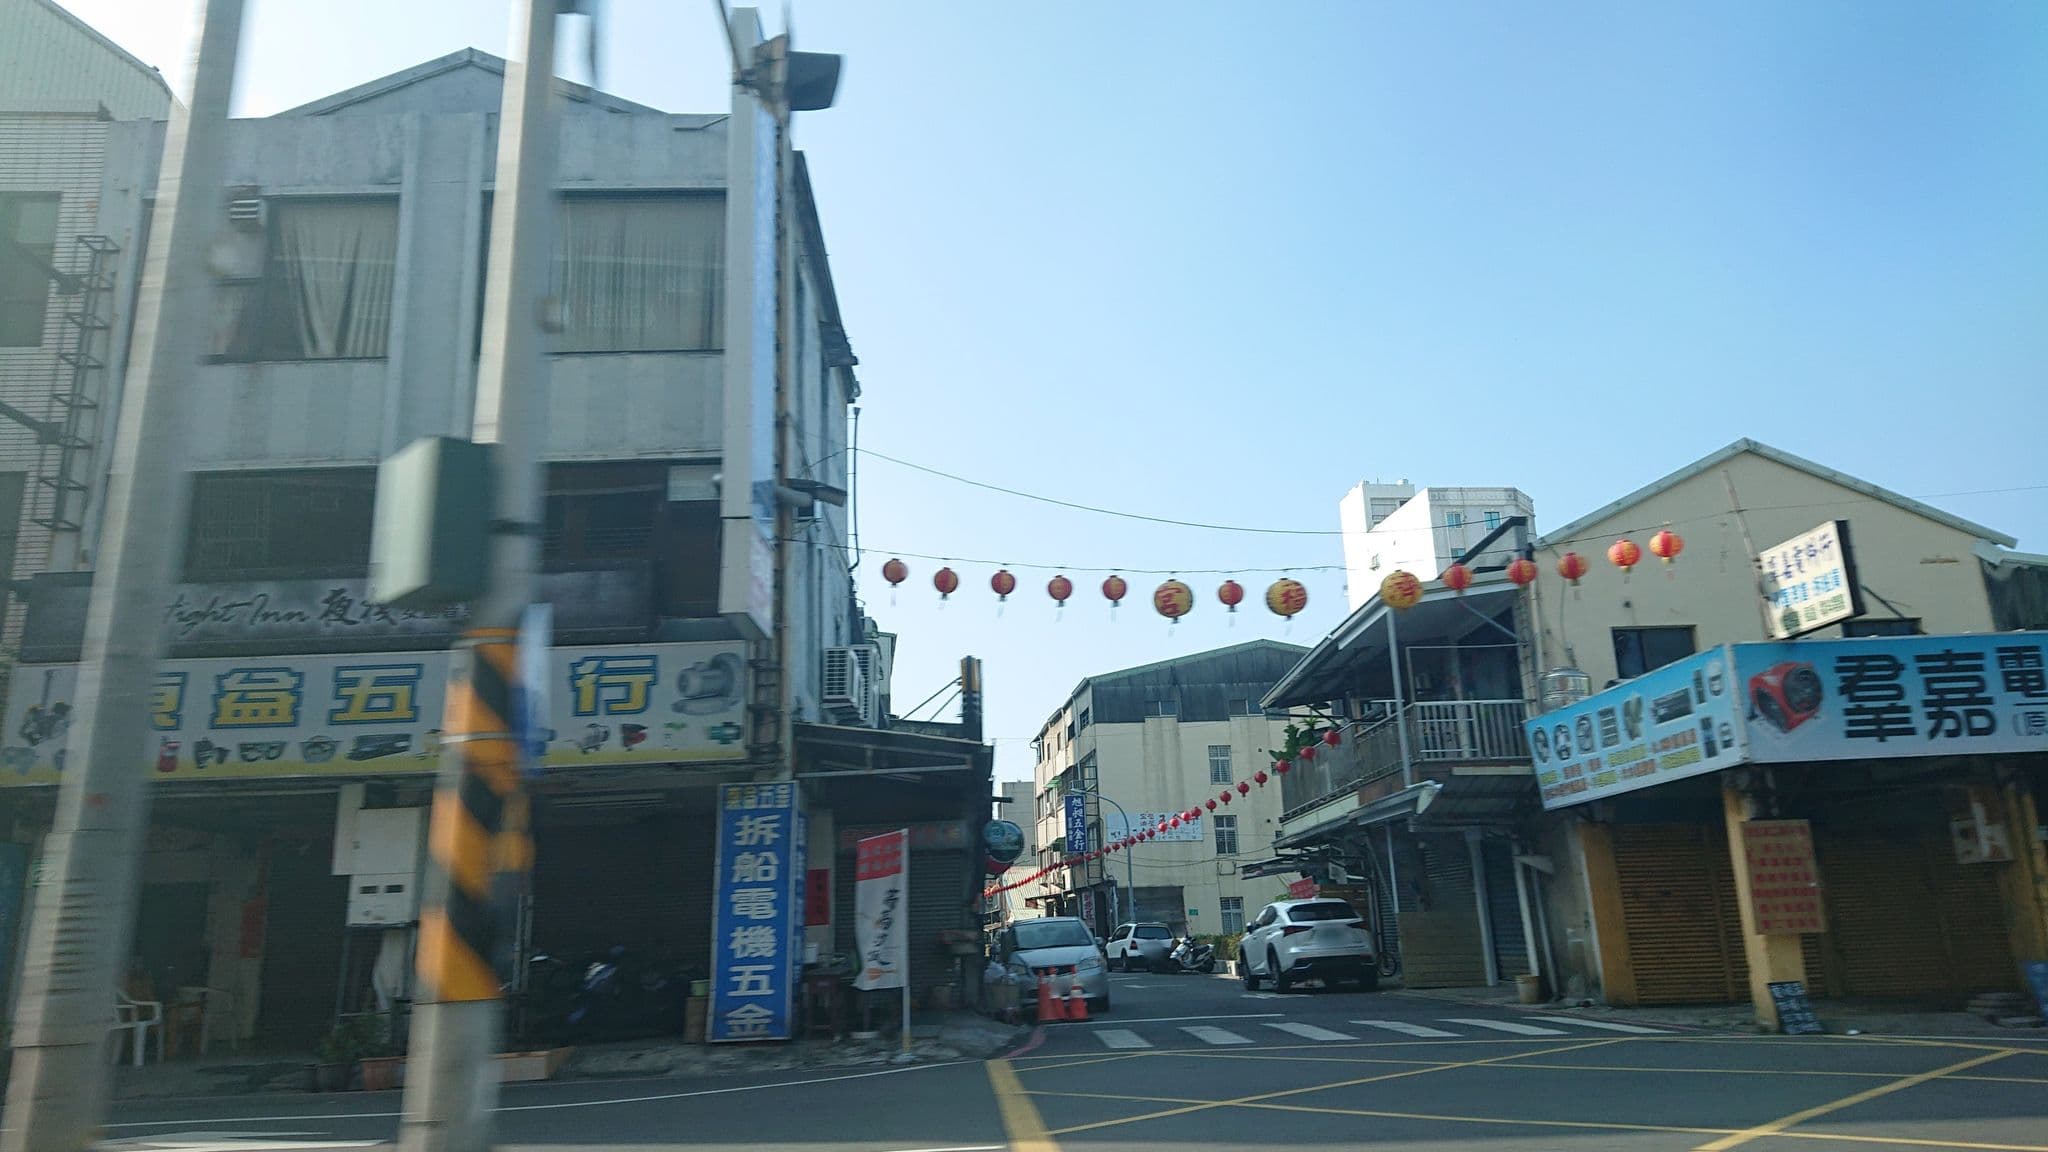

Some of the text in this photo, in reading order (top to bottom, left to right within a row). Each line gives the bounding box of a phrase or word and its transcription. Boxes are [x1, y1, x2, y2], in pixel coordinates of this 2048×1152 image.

[726, 814, 781, 1038] 拆船電機五金
